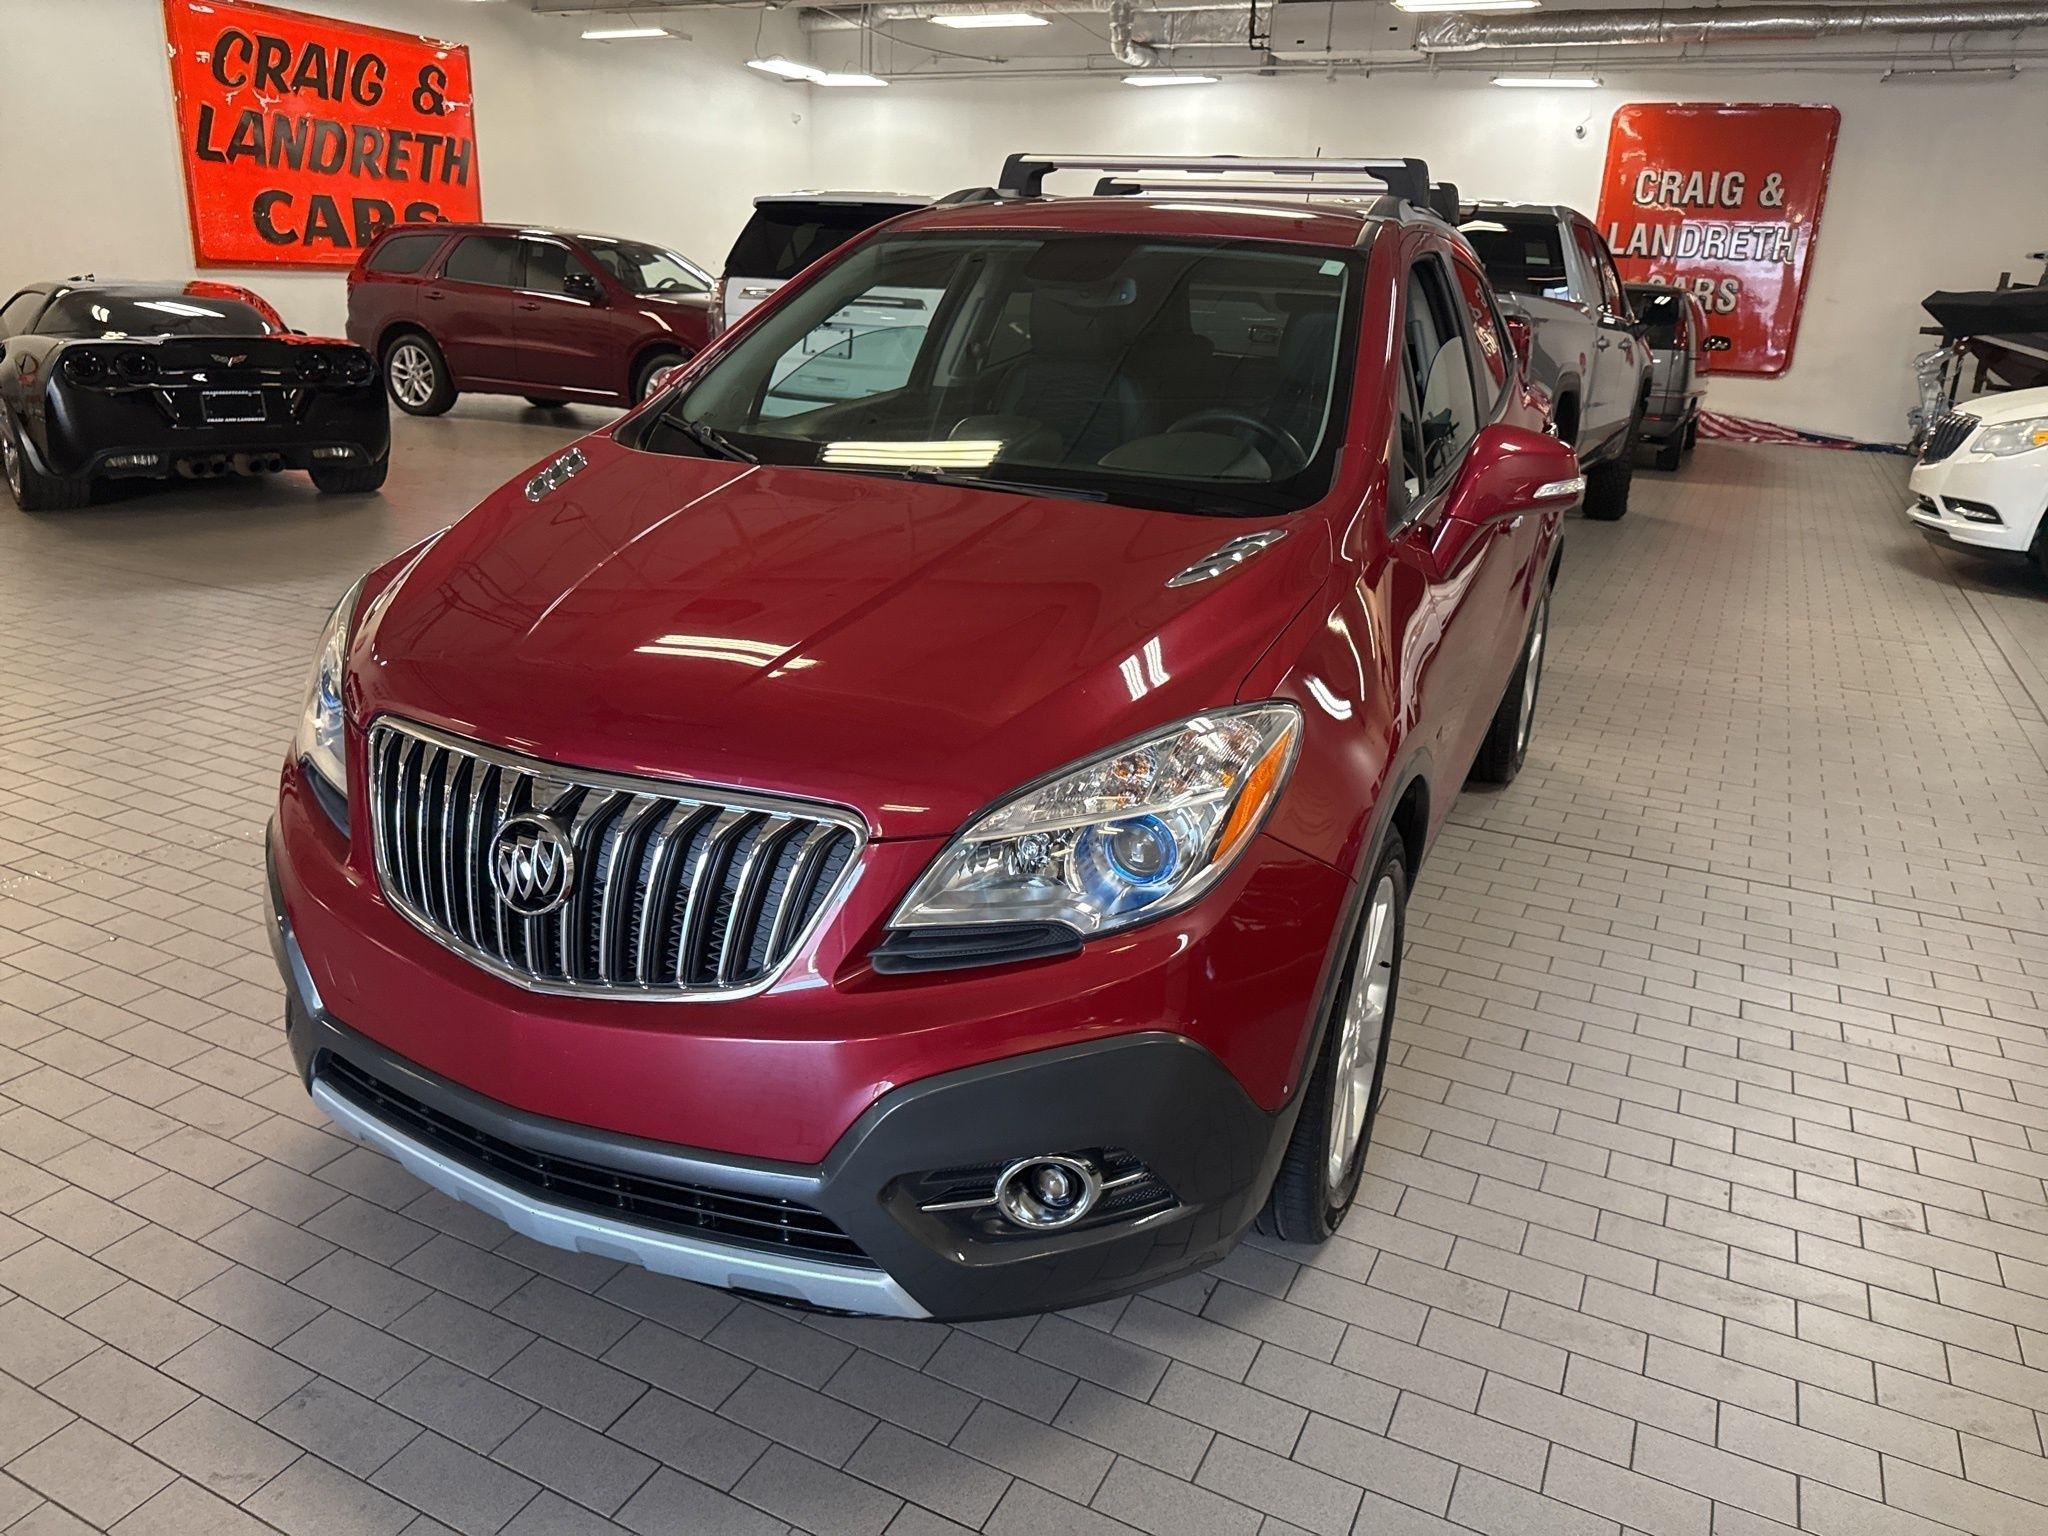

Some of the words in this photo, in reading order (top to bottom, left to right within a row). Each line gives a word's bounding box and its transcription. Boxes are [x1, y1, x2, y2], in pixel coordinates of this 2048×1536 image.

[211, 29, 387, 107] CRAIG
[411, 64, 447, 117] &
[195, 103, 472, 187] LANDRETH
[1633, 169, 1746, 208] CRAIG
[1758, 171, 1784, 209] &
[1608, 221, 1800, 264] LANDRETH
[1647, 274, 1741, 314] RS
